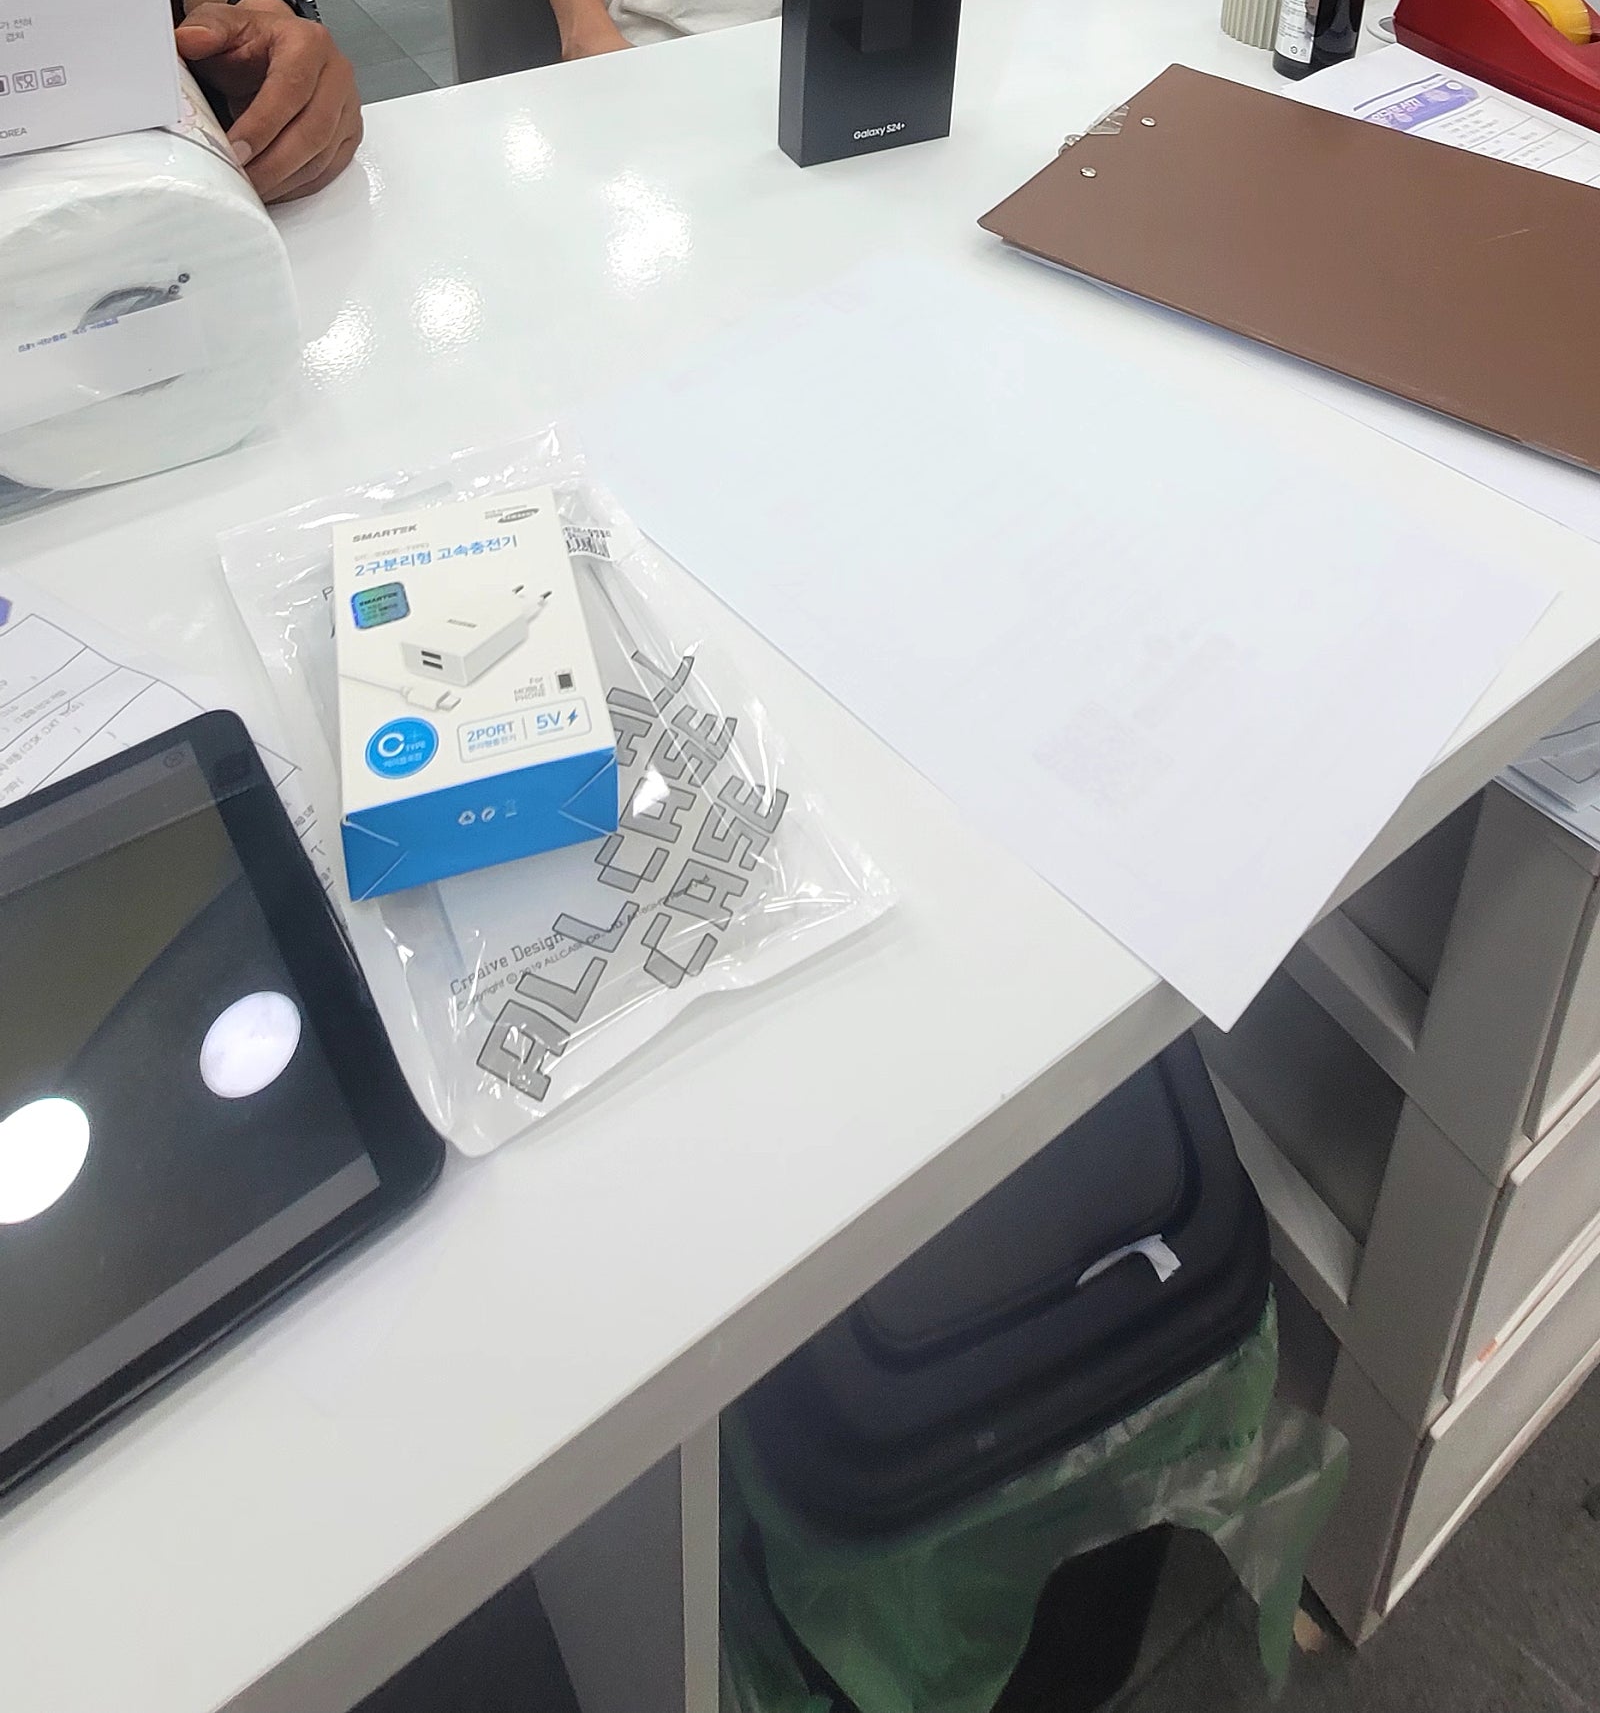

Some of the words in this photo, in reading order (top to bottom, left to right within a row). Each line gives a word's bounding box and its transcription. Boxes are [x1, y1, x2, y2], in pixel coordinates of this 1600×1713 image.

[853, 126, 886, 140] Galaxy
[352, 524, 418, 543] SMARTEK
[354, 550, 432, 578] 2구분리형
[437, 534, 518, 561] 고속충전기
[467, 720, 515, 743] 2PORT
[536, 711, 562, 729] 5V
[378, 732, 405, 757] C
[405, 740, 426, 753] TYPE
[511, 932, 567, 962] Design
